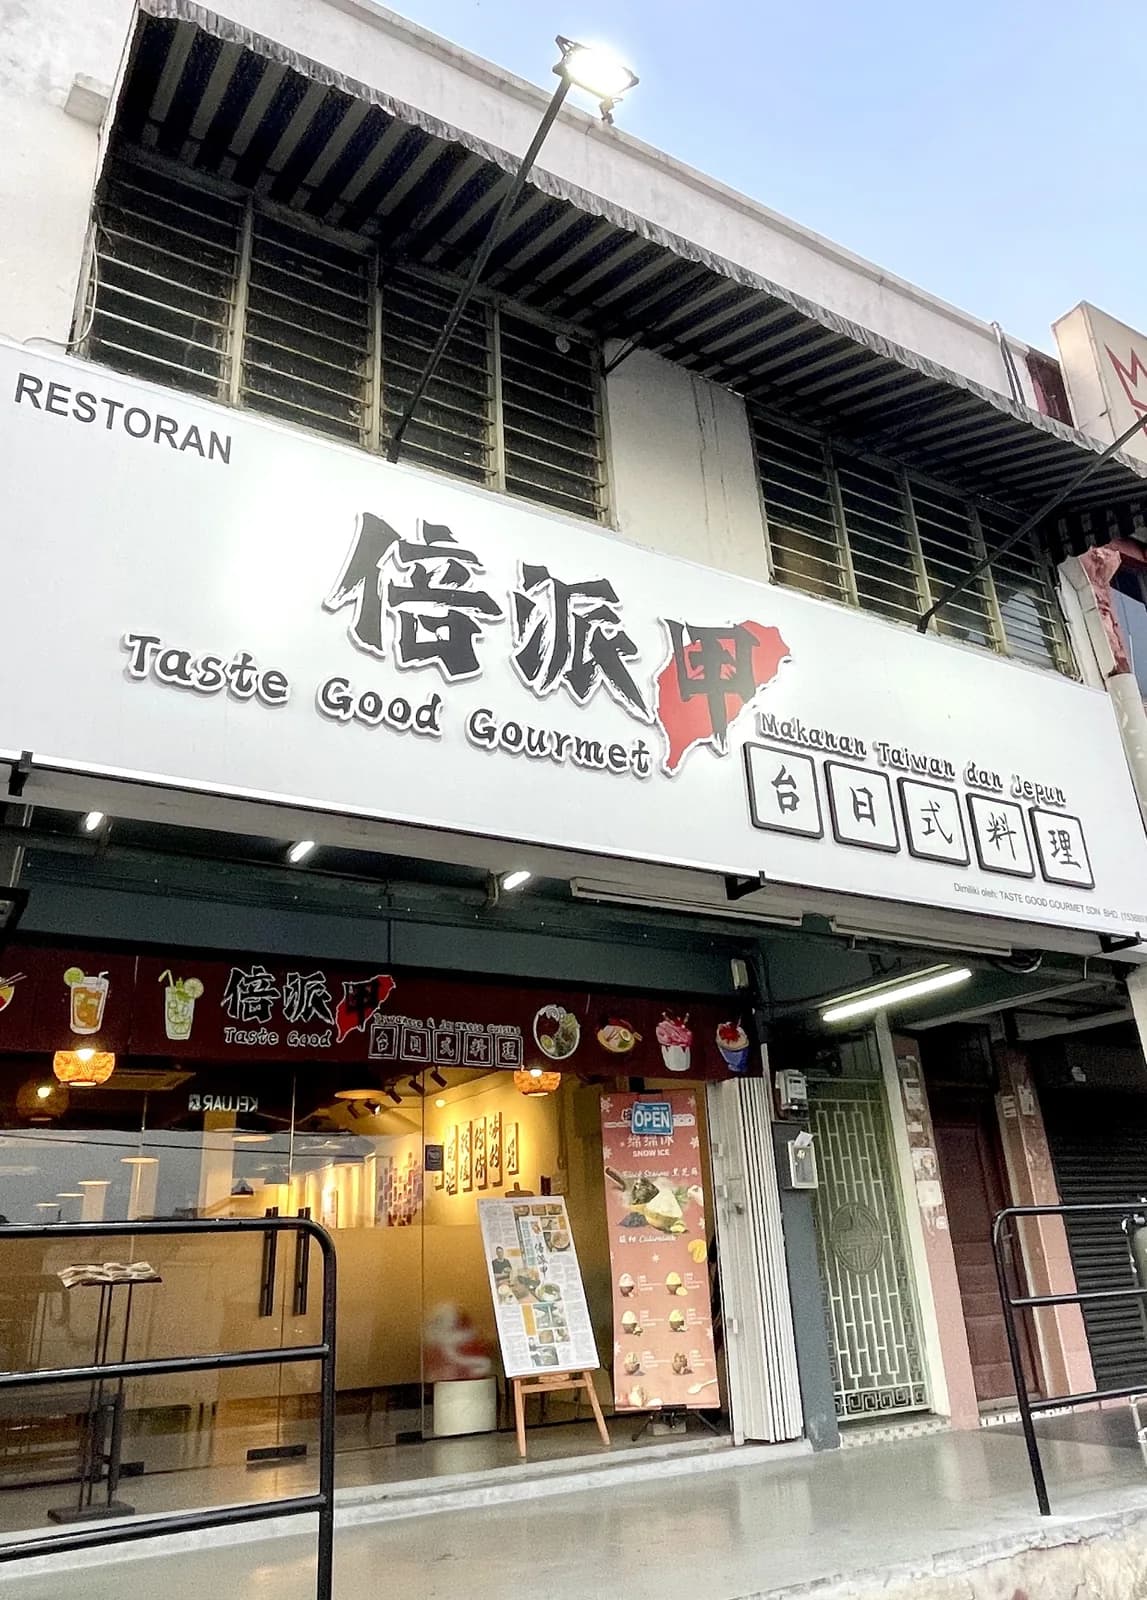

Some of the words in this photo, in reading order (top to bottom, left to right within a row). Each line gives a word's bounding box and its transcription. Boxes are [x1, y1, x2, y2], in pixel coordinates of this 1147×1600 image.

[15, 373, 232, 465] RESTORAN
[325, 510, 764, 754] 倍派甲
[125, 633, 289, 704] Taste
[320, 678, 441, 733] Good
[468, 709, 650, 775] Gourmet
[760, 712, 867, 757] Makanan
[878, 740, 956, 778] Taiwan
[966, 760, 1003, 790] dan
[1013, 774, 1067, 807] Jepun
[771, 764, 1082, 869] 台日式料理
[953, 882, 980, 896] Dimiliki
[1000, 890, 1024, 904] TASTE
[1025, 895, 1048, 908] GOOD
[1049, 899, 1084, 914] GOURMET
[223, 1026, 279, 1046] Taste
[287, 1030, 333, 1048] Good
[632, 1149, 656, 1158] SNOW
[657, 1149, 671, 1157] ICE
[634, 1110, 670, 1128] OPEN
